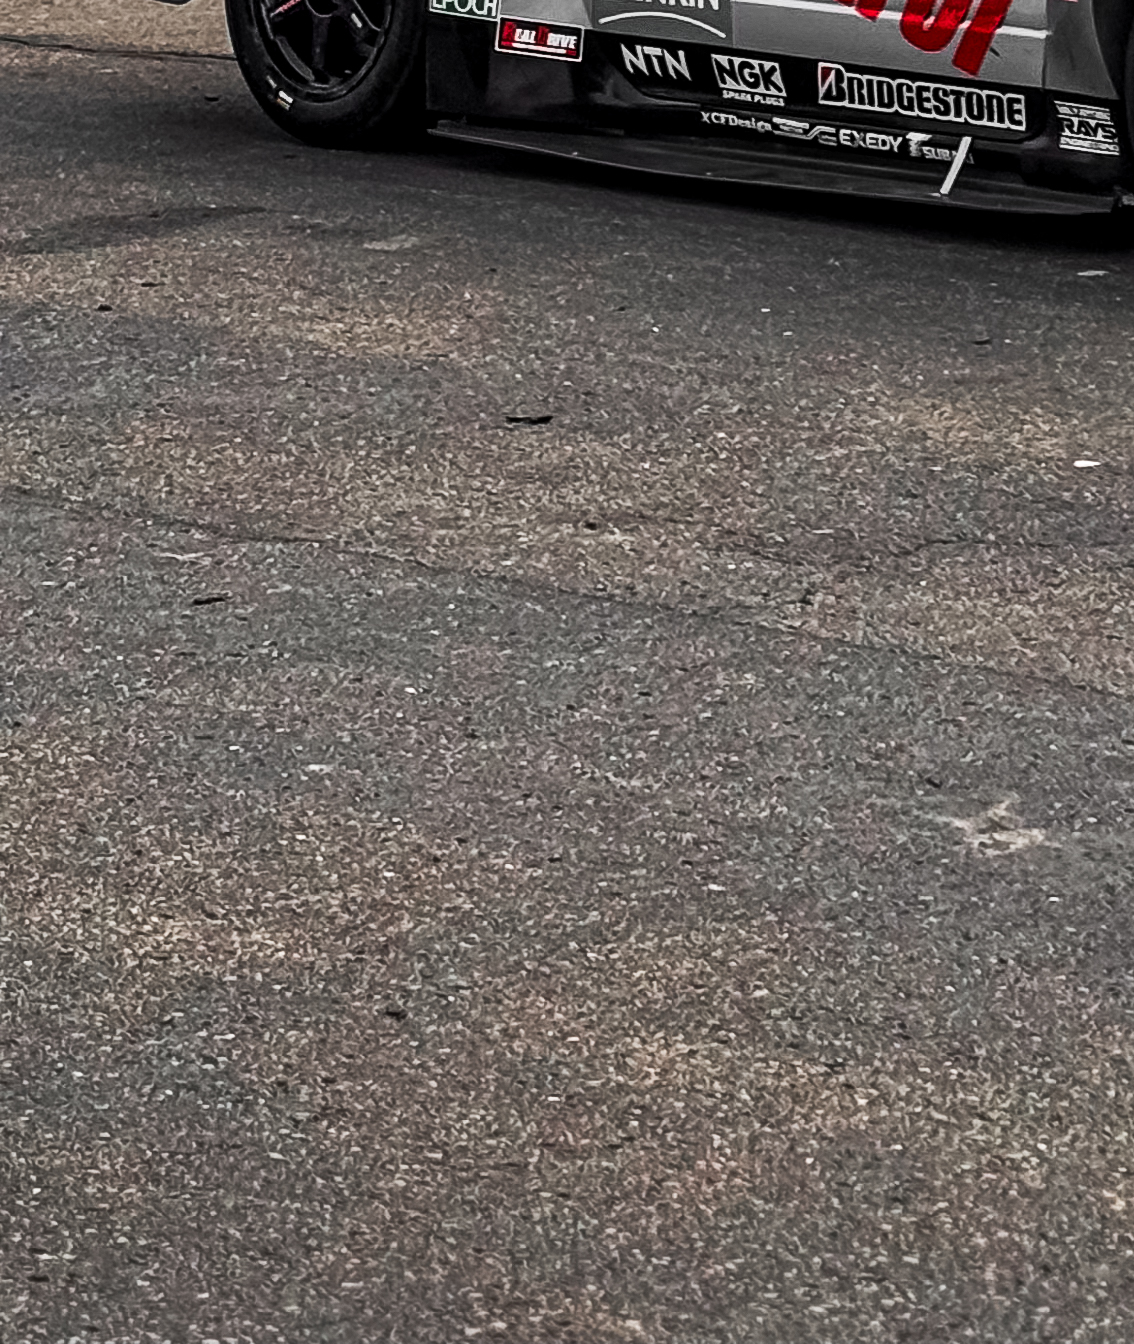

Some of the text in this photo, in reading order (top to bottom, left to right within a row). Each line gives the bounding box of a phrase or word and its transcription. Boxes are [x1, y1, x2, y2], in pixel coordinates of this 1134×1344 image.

[620, 42, 693, 82] NTN
[712, 56, 784, 95] NGK
[818, 61, 1027, 132] BRIDGESTONE
[838, 128, 904, 153] EXEDY
[1060, 117, 1118, 143] RAYS
